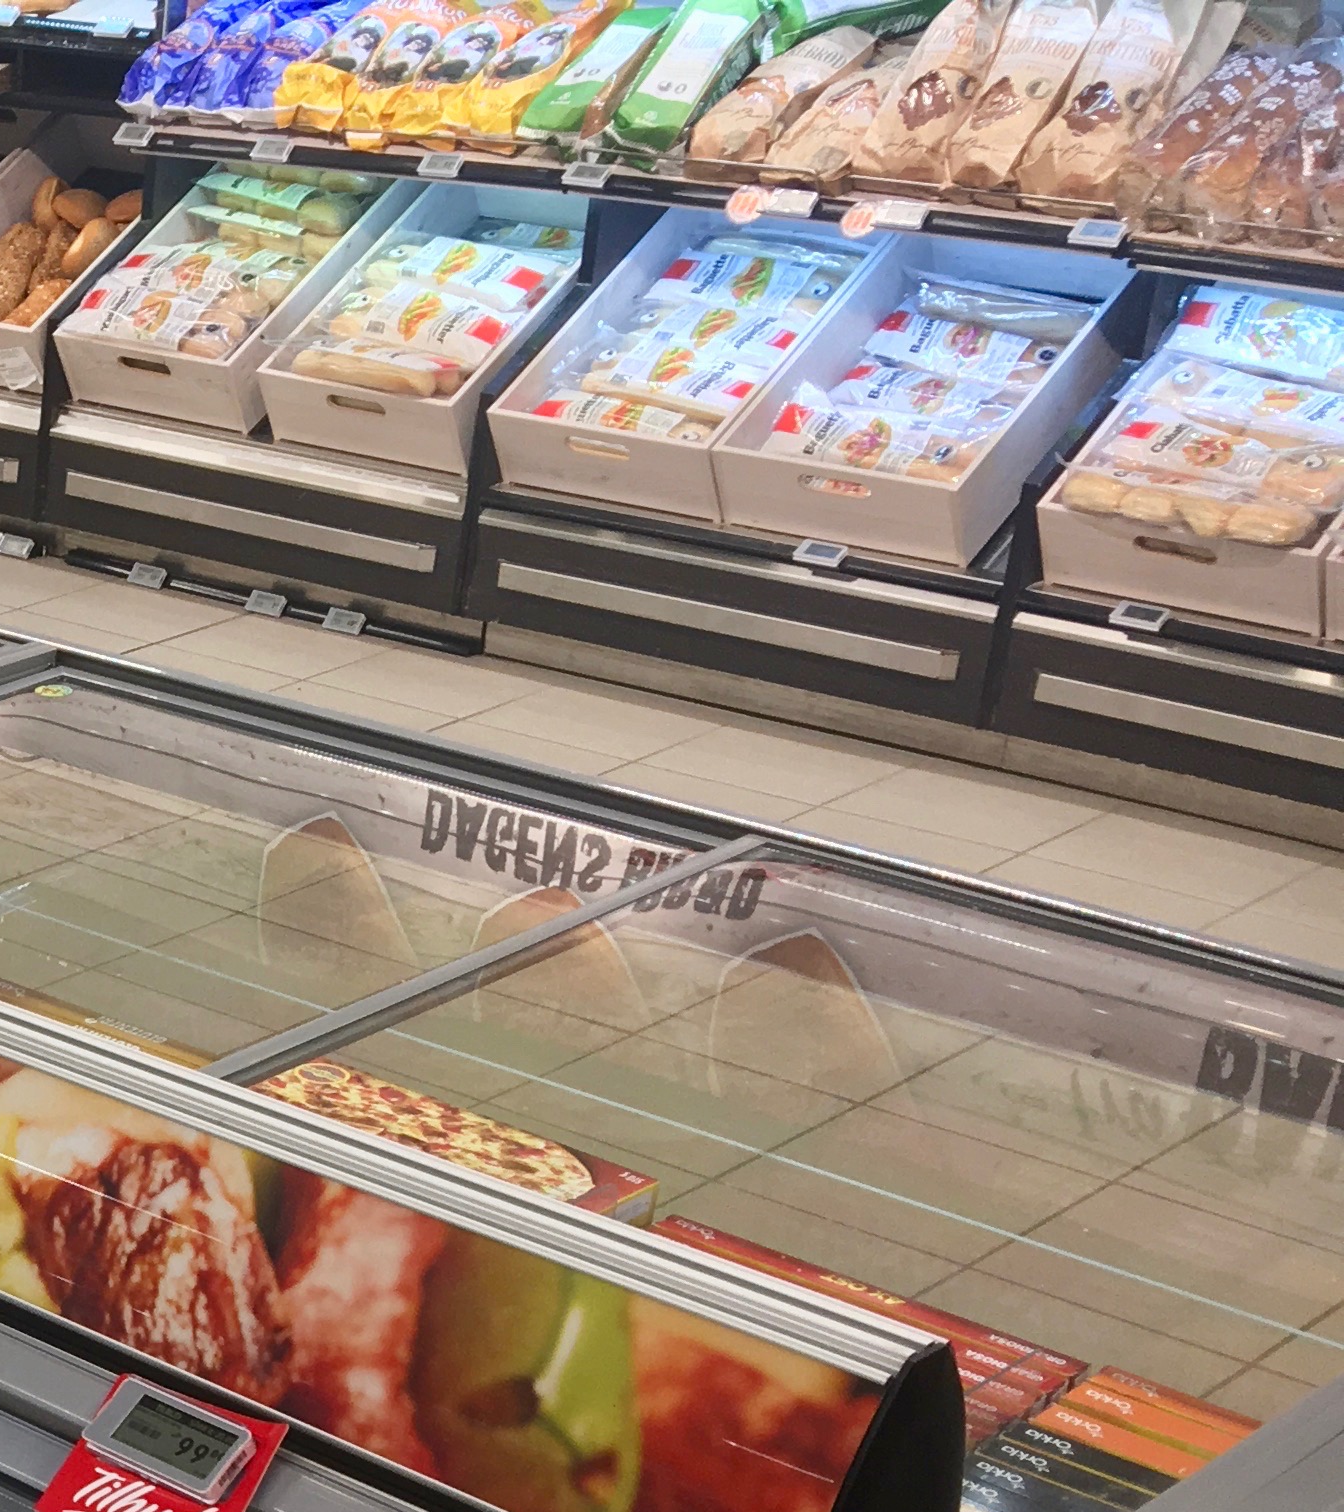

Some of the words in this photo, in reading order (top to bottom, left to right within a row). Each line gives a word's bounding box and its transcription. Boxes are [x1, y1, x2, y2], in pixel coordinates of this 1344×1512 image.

[1086, 1387, 1135, 1415] Orkla
[1056, 1411, 1103, 1439] Orkla
[1025, 1428, 1074, 1456] Orkla
[1001, 1445, 1050, 1473] Orkla
[976, 1461, 1025, 1489] Orkla
